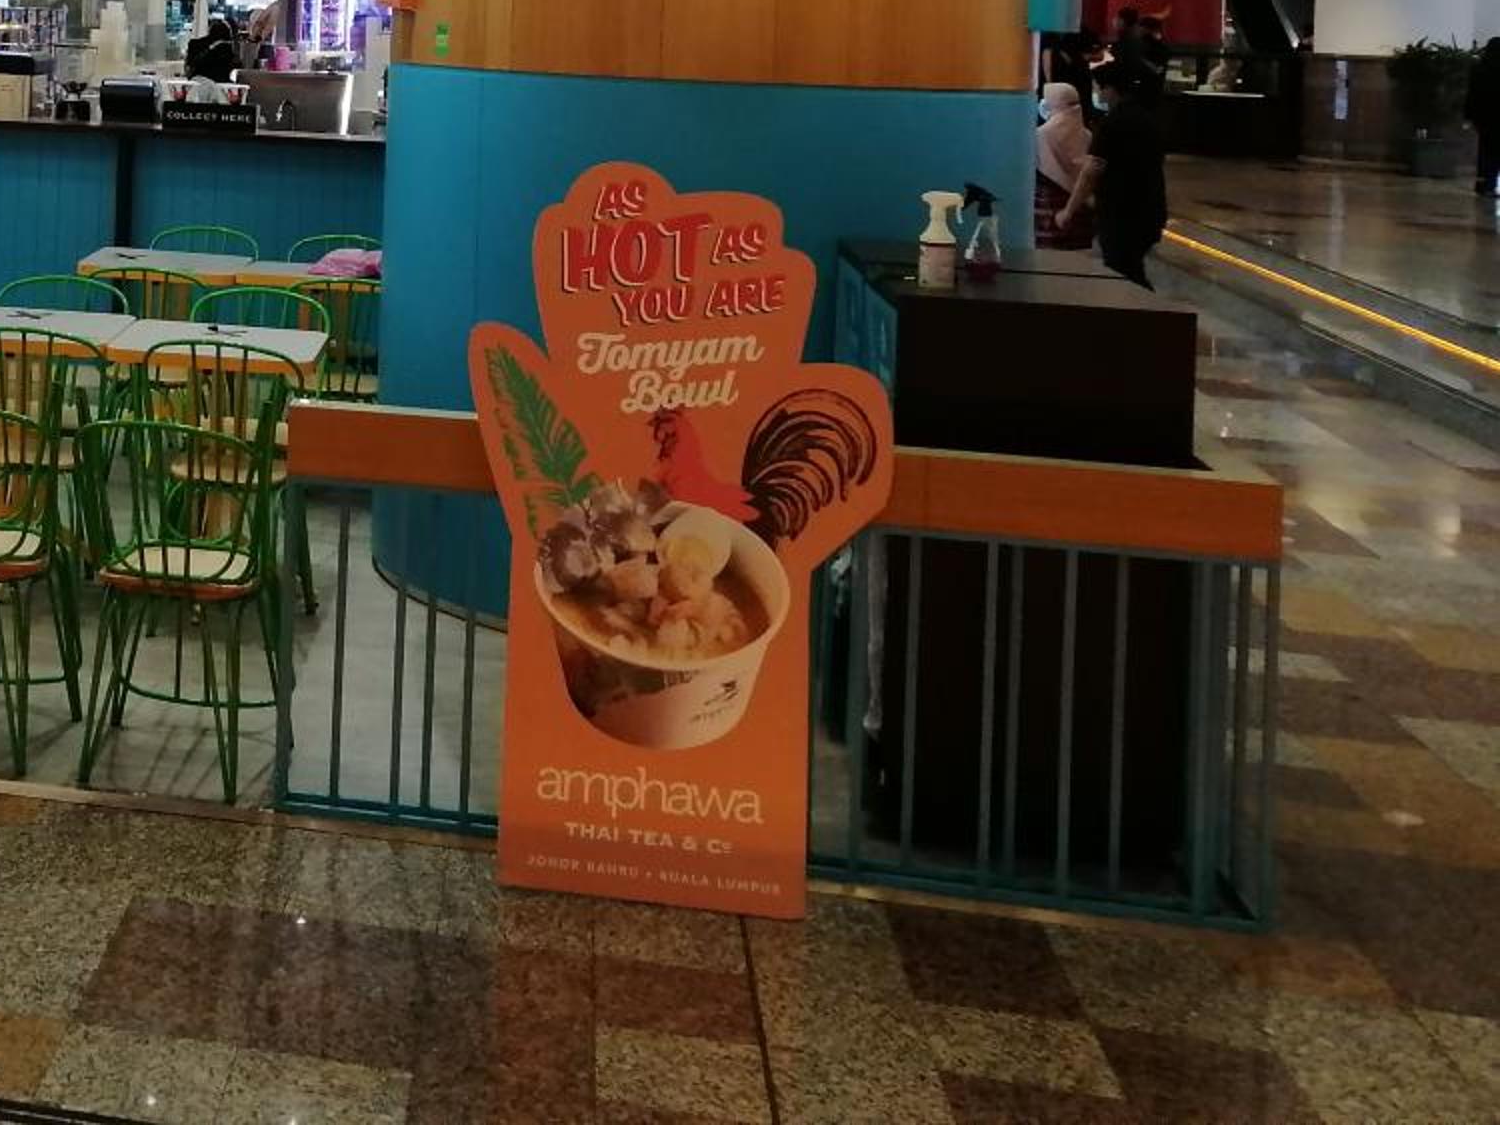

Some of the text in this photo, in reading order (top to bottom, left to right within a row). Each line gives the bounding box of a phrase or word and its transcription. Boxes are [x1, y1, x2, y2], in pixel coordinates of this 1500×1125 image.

[166, 110, 252, 123] COLLECT HERE
[592, 180, 648, 221] AS
[561, 213, 768, 293] HOT AS
[611, 275, 788, 327] YOU ARE
[577, 332, 766, 379] Tomyam
[620, 370, 740, 413] Bowl
[537, 766, 765, 825] amphawa
[564, 821, 619, 842] THAI
[628, 828, 674, 848] TEA
[681, 835, 699, 853] &
[659, 870, 710, 887] KUALA
